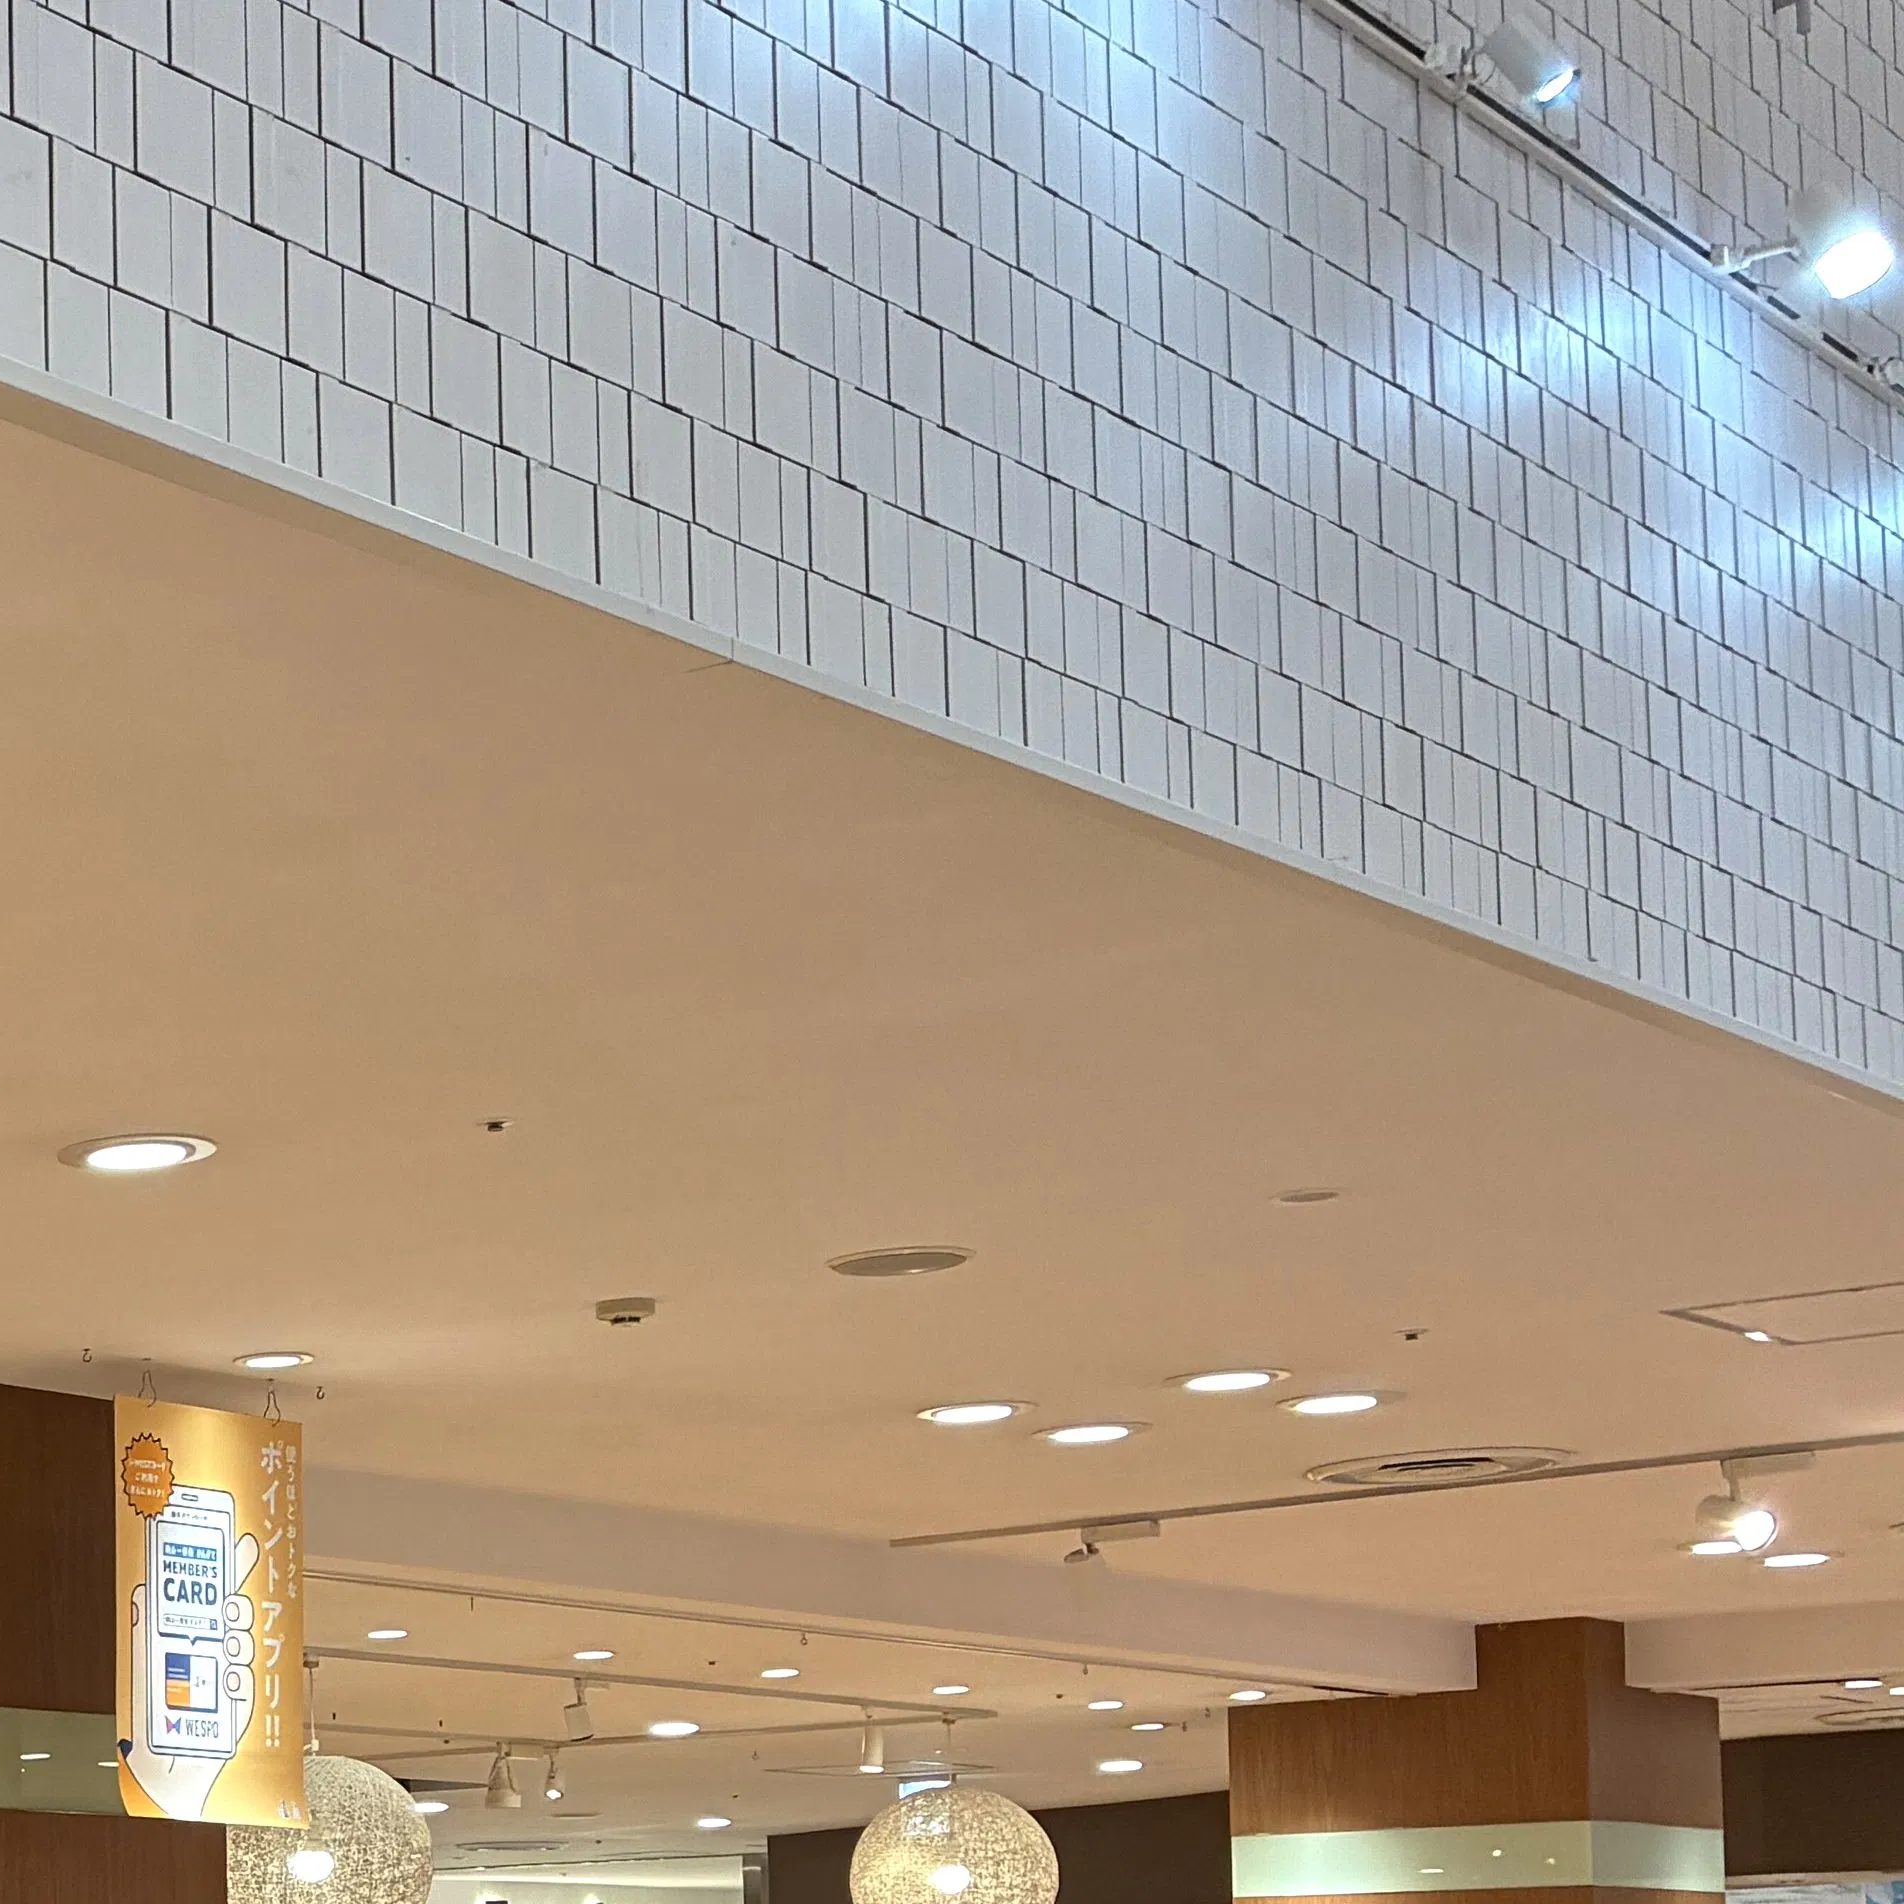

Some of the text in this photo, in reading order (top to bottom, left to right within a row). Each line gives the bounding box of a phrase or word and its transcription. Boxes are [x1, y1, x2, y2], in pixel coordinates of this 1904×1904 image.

[163, 1560, 218, 1579] MEMBER'S
[163, 1577, 217, 1606] CARD
[185, 1718, 219, 1738] WESPO
